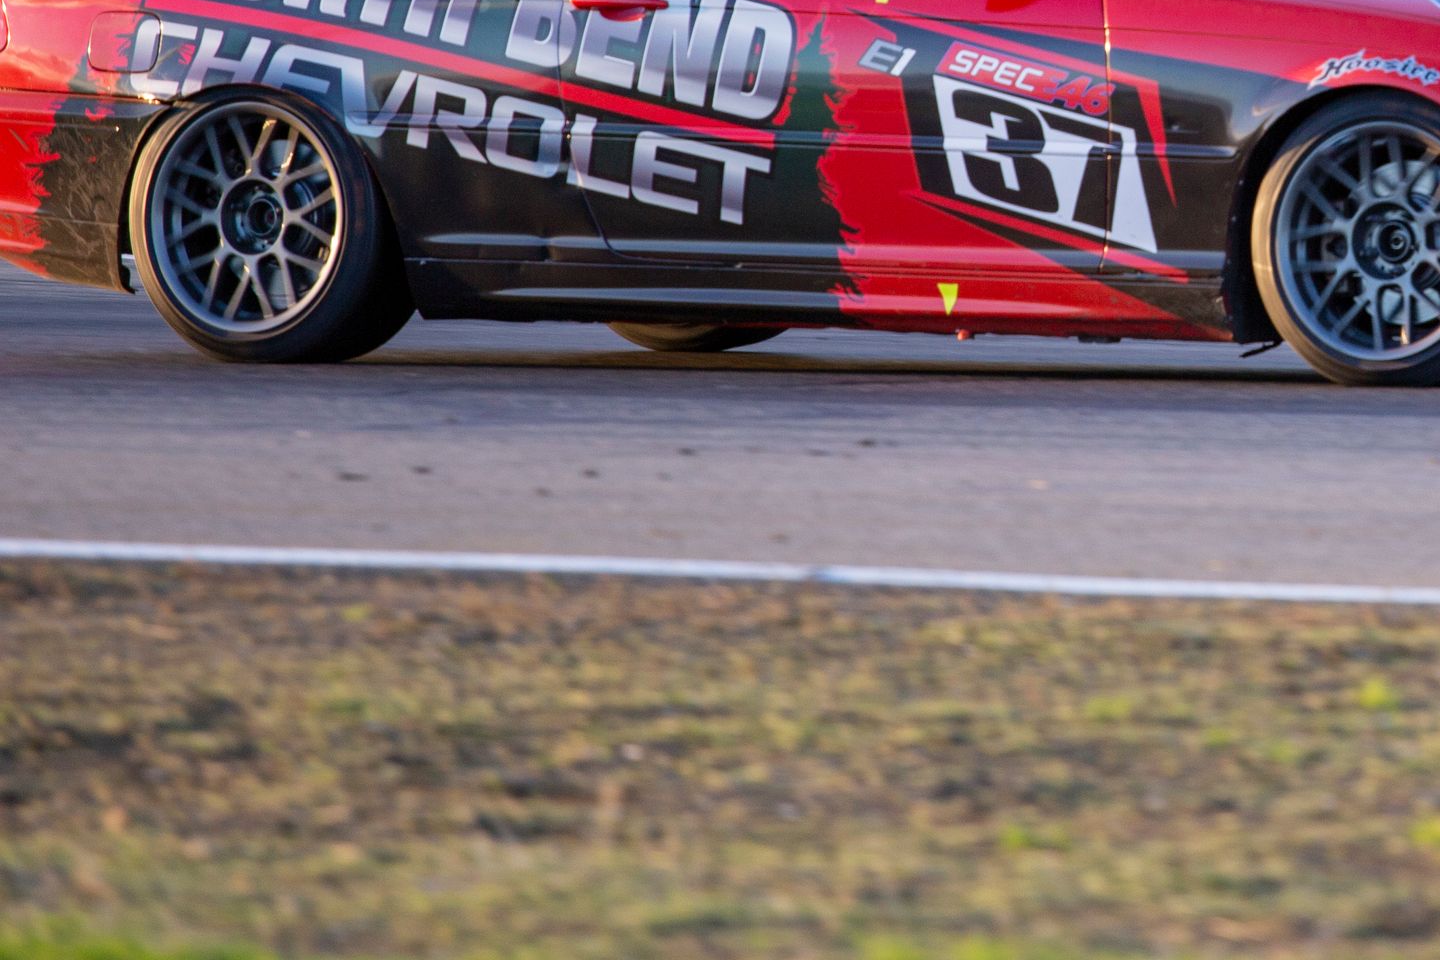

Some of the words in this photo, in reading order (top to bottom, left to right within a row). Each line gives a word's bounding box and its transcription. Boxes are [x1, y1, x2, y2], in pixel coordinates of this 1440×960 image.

[858, 39, 917, 77] E1
[948, 49, 1043, 93] SPEC
[1037, 70, 1116, 117] E46
[128, 18, 773, 227] CHEVROLET
[951, 87, 1122, 234] 37
